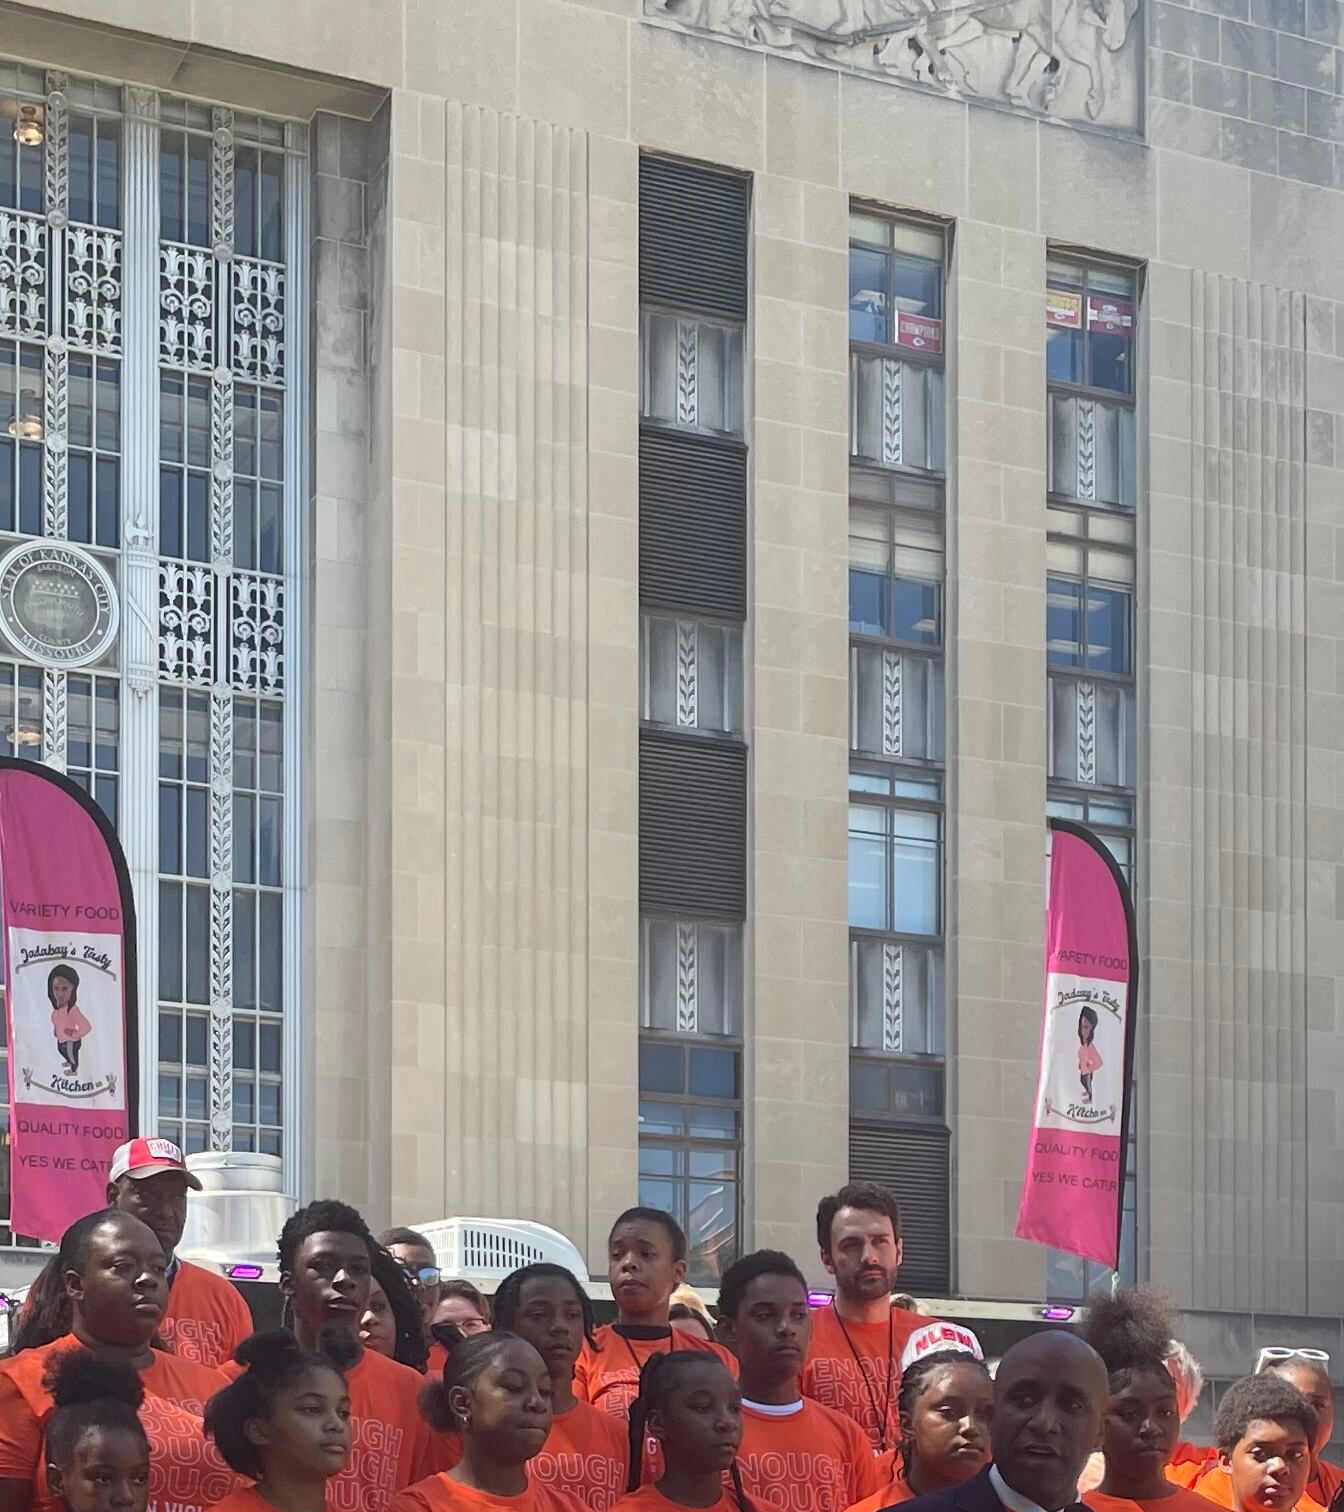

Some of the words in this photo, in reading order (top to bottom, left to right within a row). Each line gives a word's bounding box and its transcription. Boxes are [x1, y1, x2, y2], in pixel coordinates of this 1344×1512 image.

[19, 552, 35, 568] OF
[40, 549, 94, 580] KANSAS
[95, 583, 111, 614] CITY
[20, 634, 92, 659] MISSOURI
[10, 901, 71, 917] VARIETY
[76, 906, 120, 920] FOOD
[83, 945, 112, 970] Tasty
[1100, 955, 1128, 970] FOOD
[50, 1074, 94, 1092] Kitchen
[17, 1120, 79, 1136] QUALITY
[83, 1126, 124, 1140] FOOD
[1035, 1142, 1088, 1158] QUALITY
[19, 1154, 49, 1168] YES
[52, 1157, 76, 1170] WE
[1032, 1171, 1055, 1184] YES
[1058, 1173, 1079, 1187] WE
[915, 1326, 975, 1353] NLBM
[812, 1357, 900, 1383] ENOU
[525, 1452, 625, 1489] OUGH
[735, 1451, 852, 1490] NOUGH
